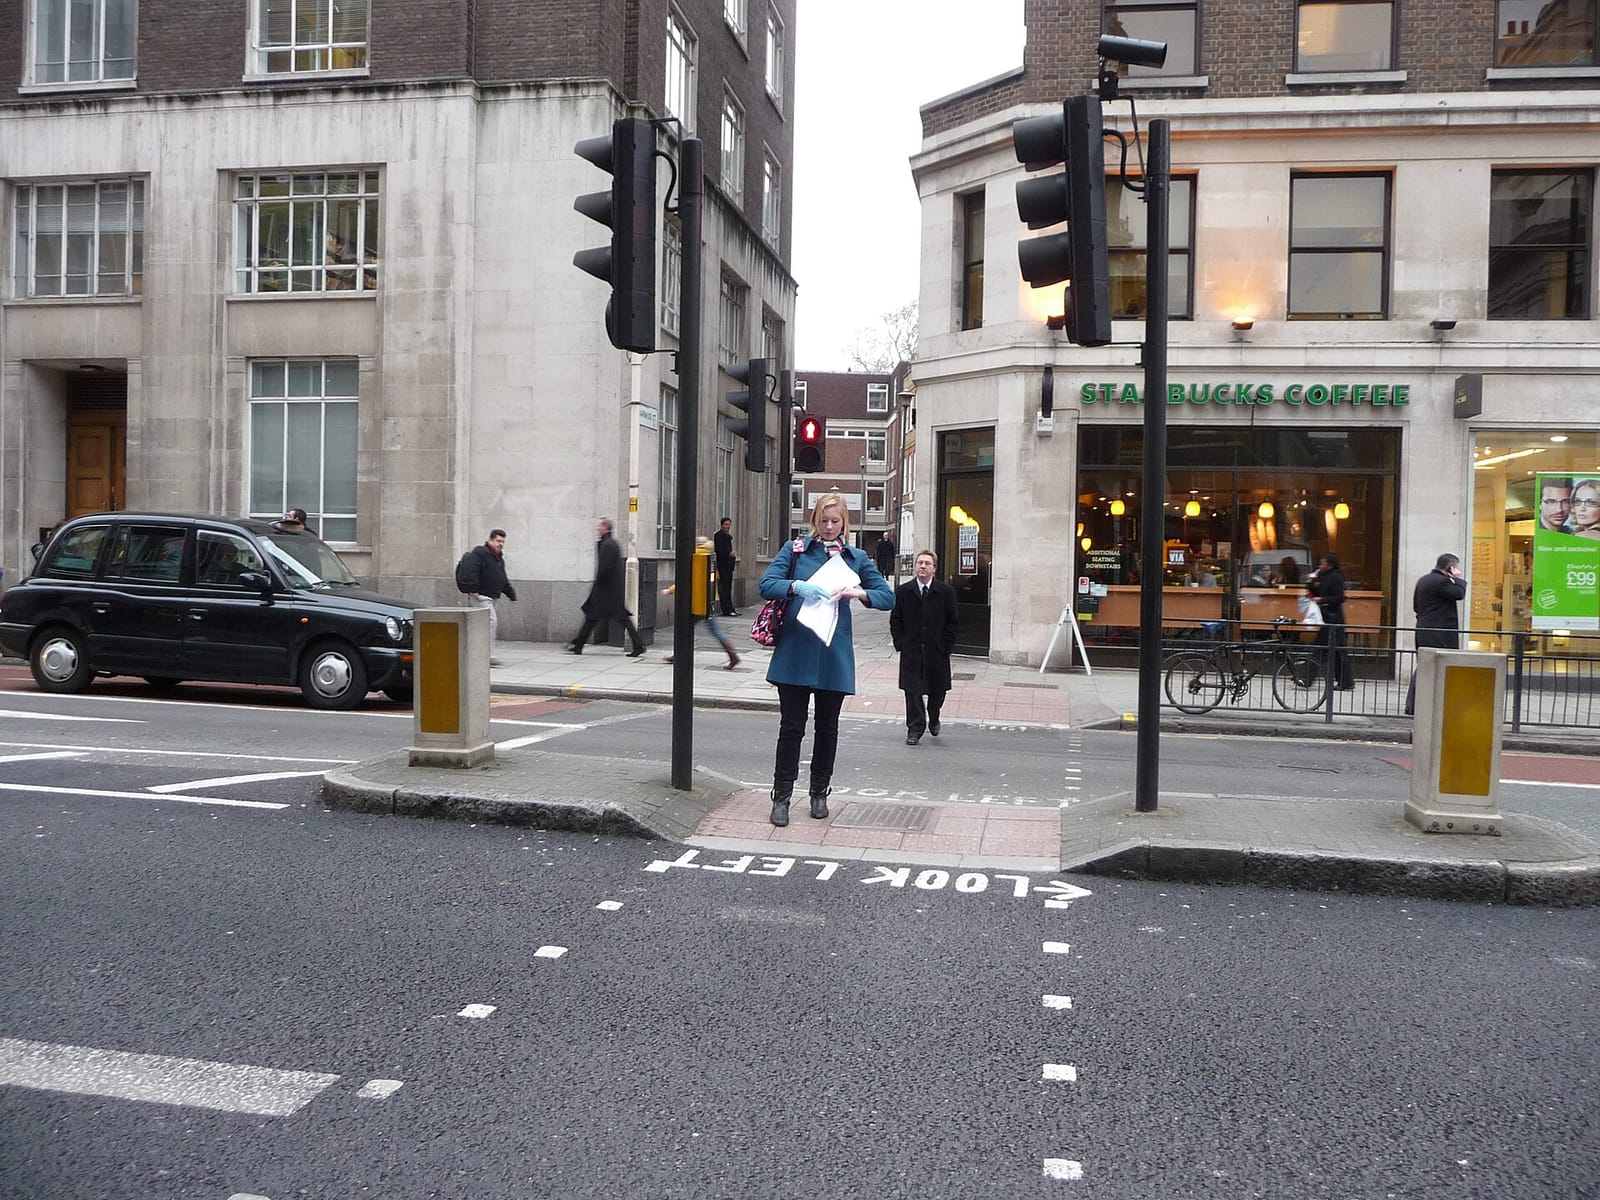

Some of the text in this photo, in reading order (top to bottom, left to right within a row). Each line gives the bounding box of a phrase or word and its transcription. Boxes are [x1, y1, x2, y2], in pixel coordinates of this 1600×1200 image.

[1080, 382, 1411, 406] STABUCKS COFFEE
[962, 556, 975, 565] VIA
[1169, 553, 1185, 562] VIA
[1567, 571, 1597, 586] £99
[643, 850, 1029, 898] LOOK LEFT
